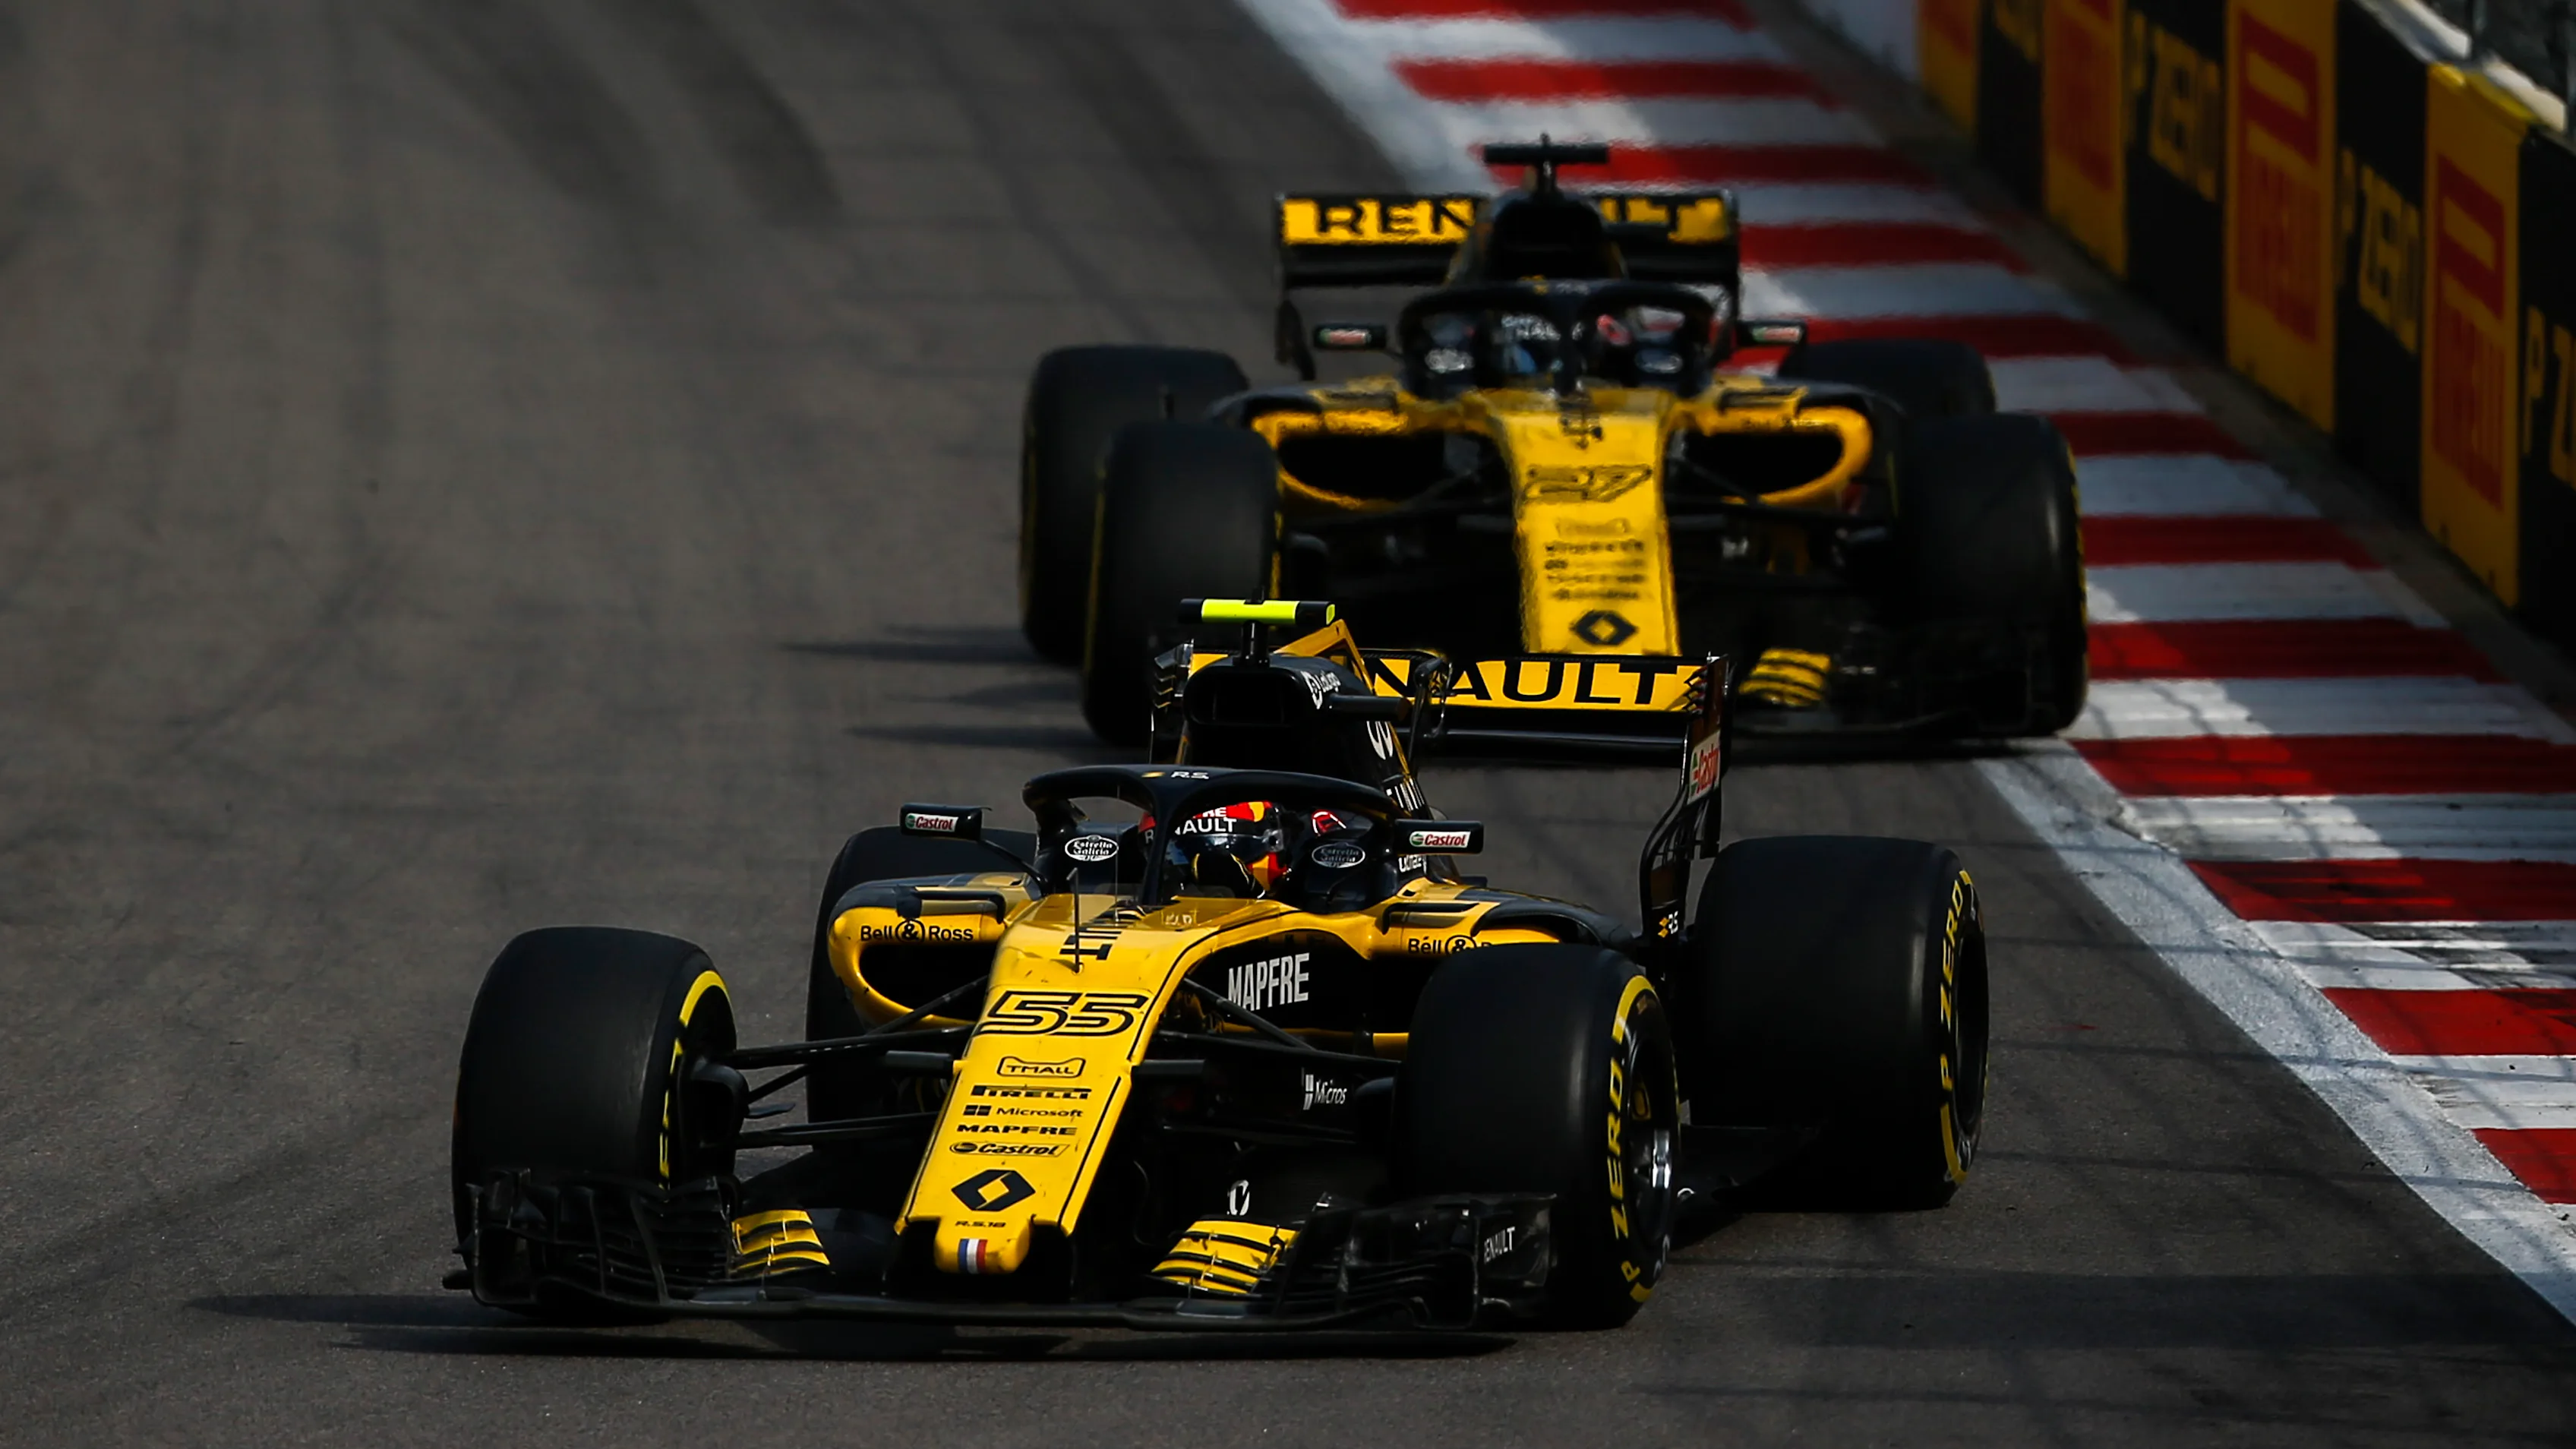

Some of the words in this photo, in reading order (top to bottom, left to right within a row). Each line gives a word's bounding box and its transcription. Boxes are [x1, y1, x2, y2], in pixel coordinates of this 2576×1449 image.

[1365, 658, 1678, 705] NAULT
[915, 816, 954, 831] Castrol
[1425, 834, 1466, 847] Castrol
[861, 926, 892, 942] Bell
[929, 927, 974, 942] Ross
[1940, 879, 1964, 1034] ZERO
[1228, 952, 1310, 1012] MAPFRE
[972, 990, 1148, 1036] 55
[1006, 1065, 1074, 1075] TMALL
[971, 1085, 1092, 1100] PIRELLI
[996, 1107, 1084, 1117] Microsoft
[957, 1125, 1078, 1135] MAPFRE
[979, 1143, 1059, 1155] Castrol
[1607, 1056, 1629, 1241] ZERO
